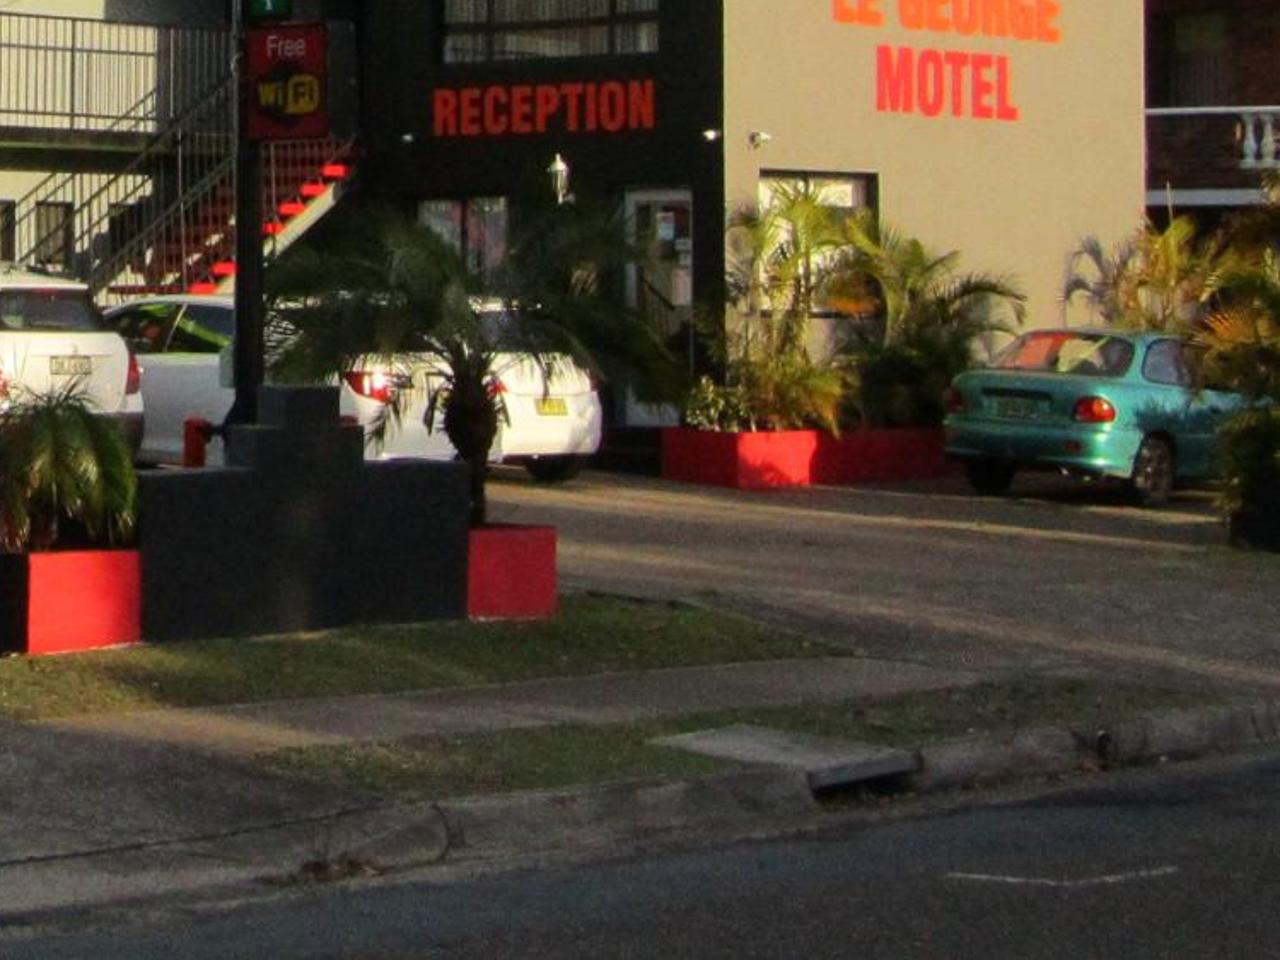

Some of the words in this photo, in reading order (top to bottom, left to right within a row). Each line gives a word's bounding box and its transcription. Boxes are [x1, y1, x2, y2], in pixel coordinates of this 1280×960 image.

[266, 36, 306, 57] Free
[433, 79, 656, 136] RECEPTION
[876, 44, 1020, 121] MOTEL
